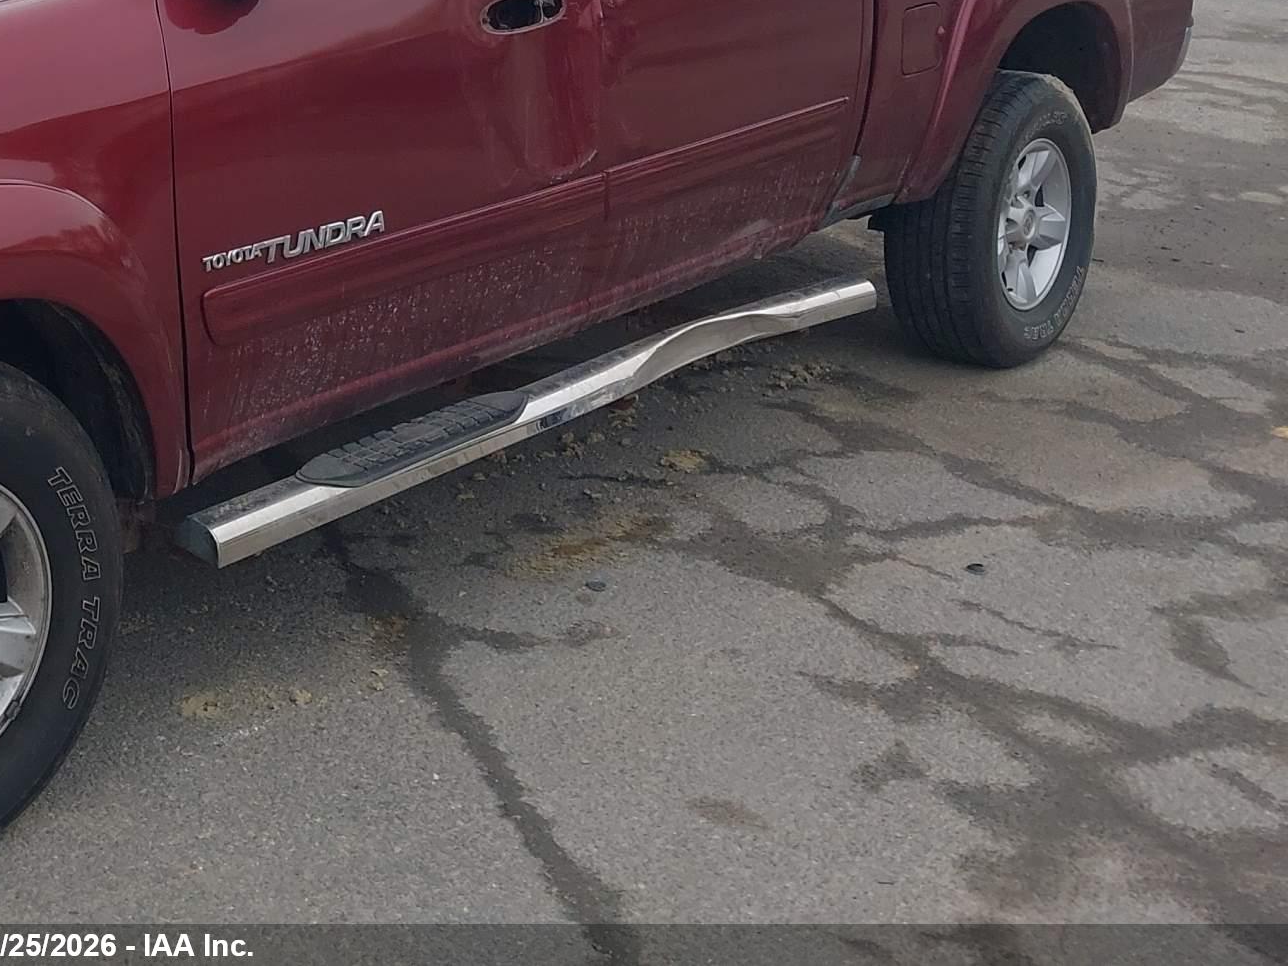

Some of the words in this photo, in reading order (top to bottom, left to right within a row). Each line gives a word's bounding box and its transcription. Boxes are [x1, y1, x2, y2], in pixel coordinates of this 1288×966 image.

[202, 246, 263, 272] TOYOTA
[261, 210, 385, 263] TUNDRA
[46, 465, 103, 582] TERRA
[62, 595, 101, 711] TRAC
